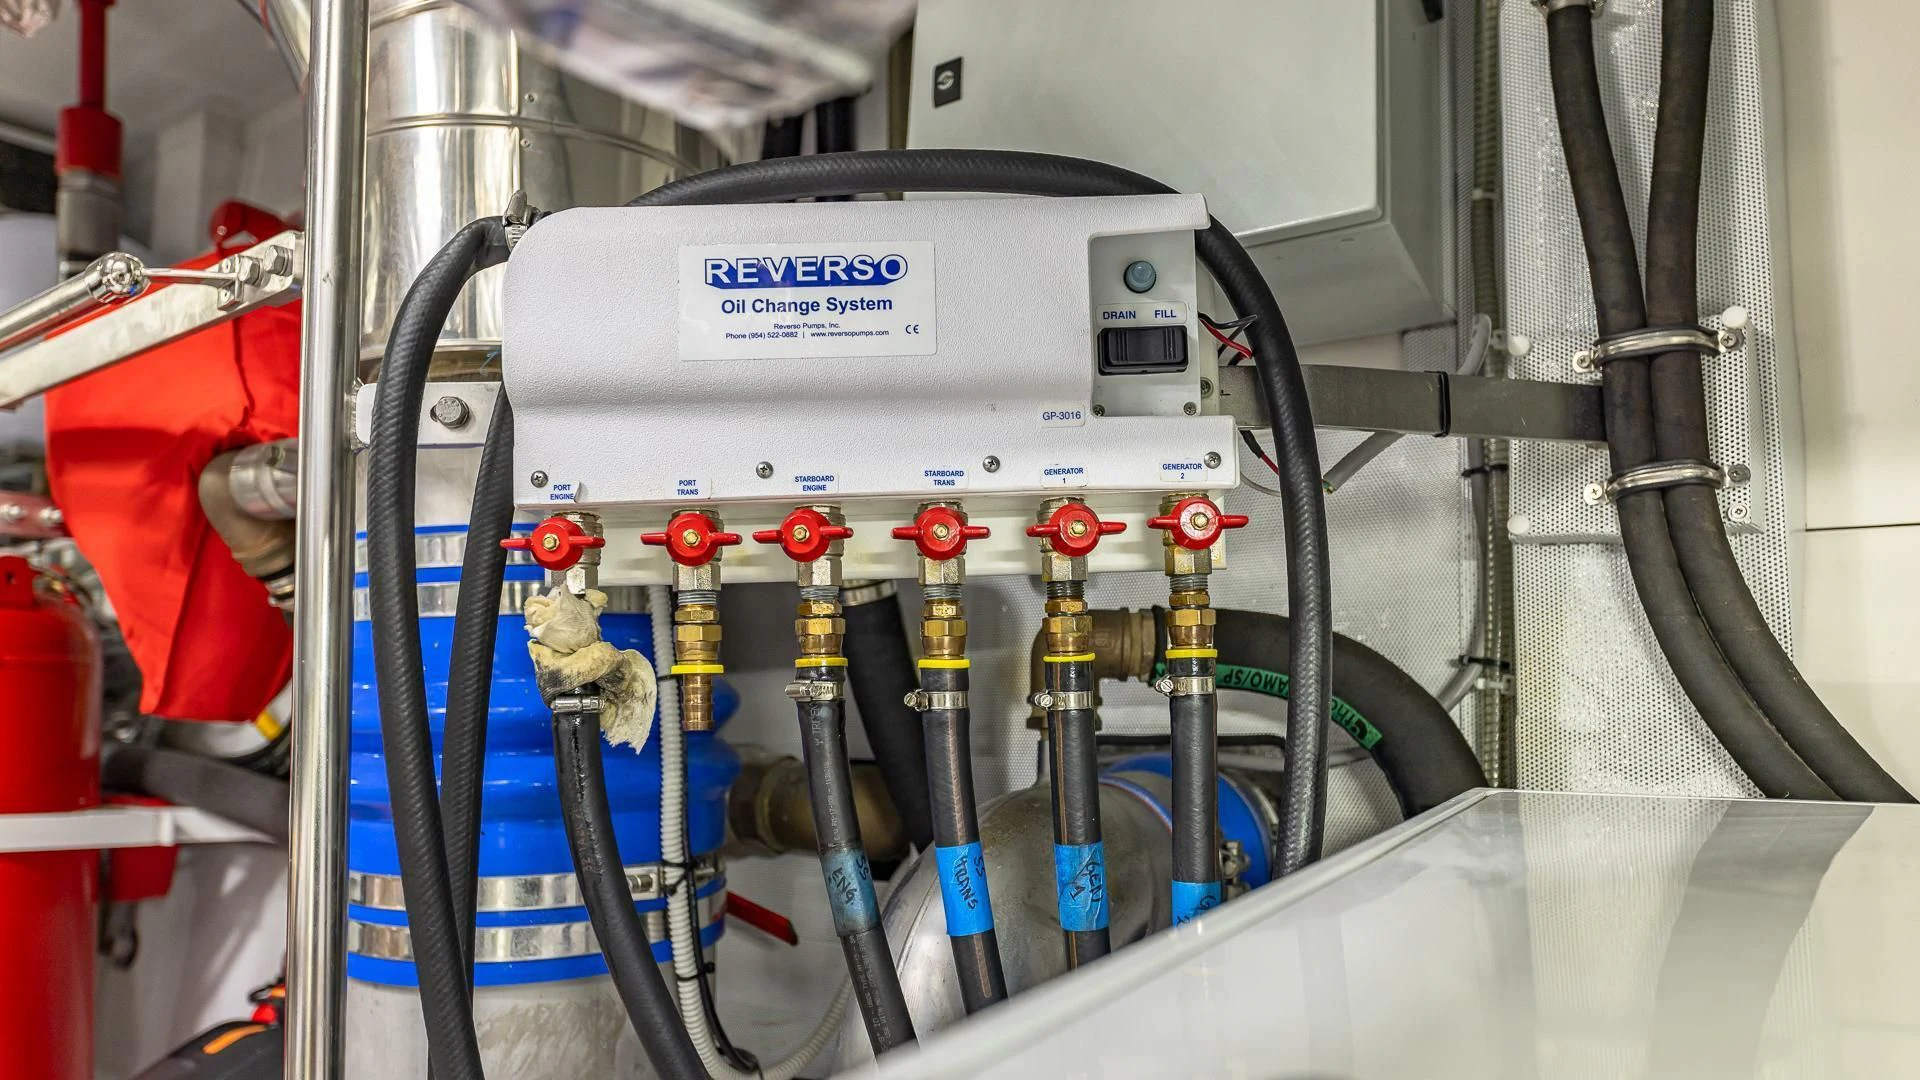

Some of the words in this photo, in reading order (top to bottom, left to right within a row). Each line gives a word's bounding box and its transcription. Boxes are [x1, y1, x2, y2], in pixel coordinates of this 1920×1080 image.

[705, 254, 908, 289] REVERSO
[721, 299, 746, 314] Oil
[752, 298, 820, 316] Change
[826, 297, 893, 316] System
[1102, 310, 1137, 321] DRAIN
[1154, 309, 1177, 319] FILL
[802, 322, 827, 331] Pumps,
[905, 324, 919, 335] CE
[725, 332, 747, 340] Phone
[748, 332, 766, 340] (954)
[767, 331, 798, 339] 522-0882
[810, 329, 889, 339] www.reversopumps.com
[1042, 410, 1081, 421] GP-3016
[1161, 462, 1203, 471] GENERATOR
[924, 469, 965, 478] STARBOARD
[1043, 467, 1084, 476] GENERATOR
[1180, 472, 1185, 480] 2
[678, 479, 697, 487] PORT
[794, 475, 835, 483] STARBOARD
[933, 478, 956, 487] TRANS
[553, 484, 571, 492] PORT
[677, 487, 699, 496] TRANS
[802, 483, 827, 492] ENGINE
[550, 492, 575, 501] ENGINE
